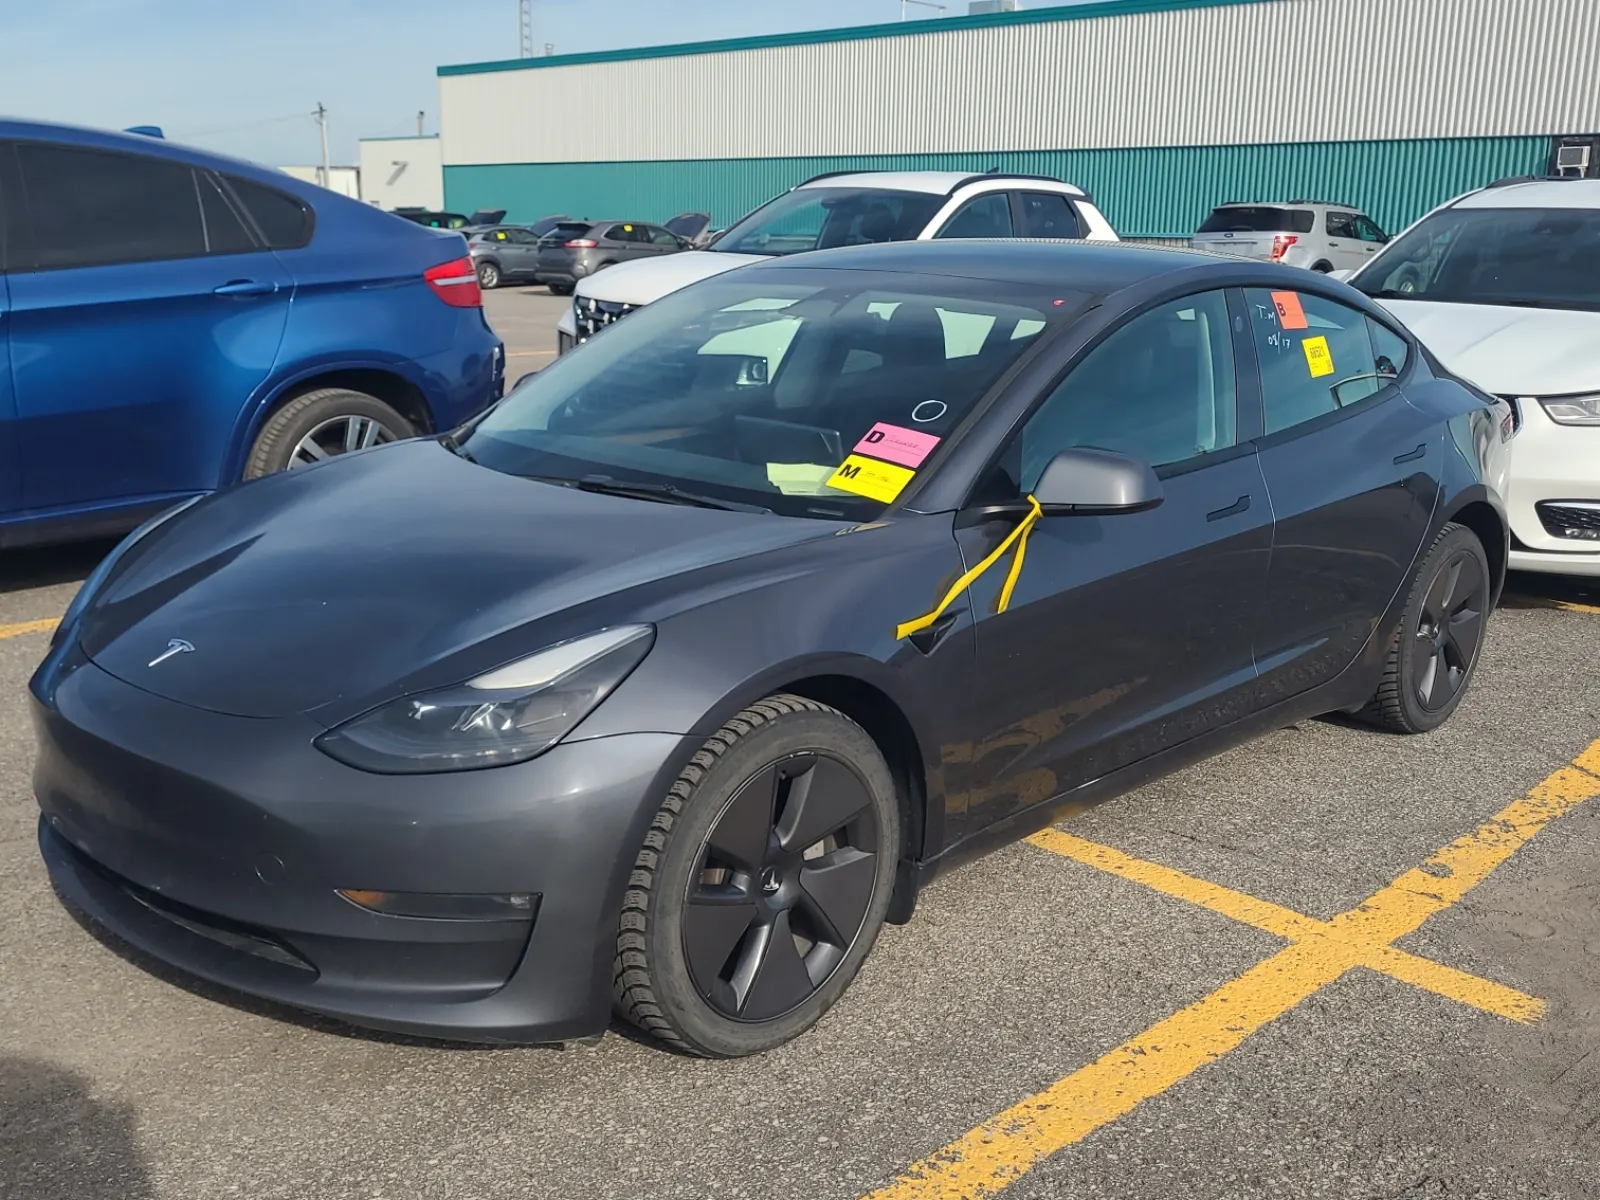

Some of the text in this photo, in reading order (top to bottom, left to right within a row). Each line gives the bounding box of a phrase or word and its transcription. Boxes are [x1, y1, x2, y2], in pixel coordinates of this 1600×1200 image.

[386, 160, 408, 186] 7
[1276, 302, 1287, 317] B
[865, 430, 885, 444] D
[838, 464, 862, 479] M
